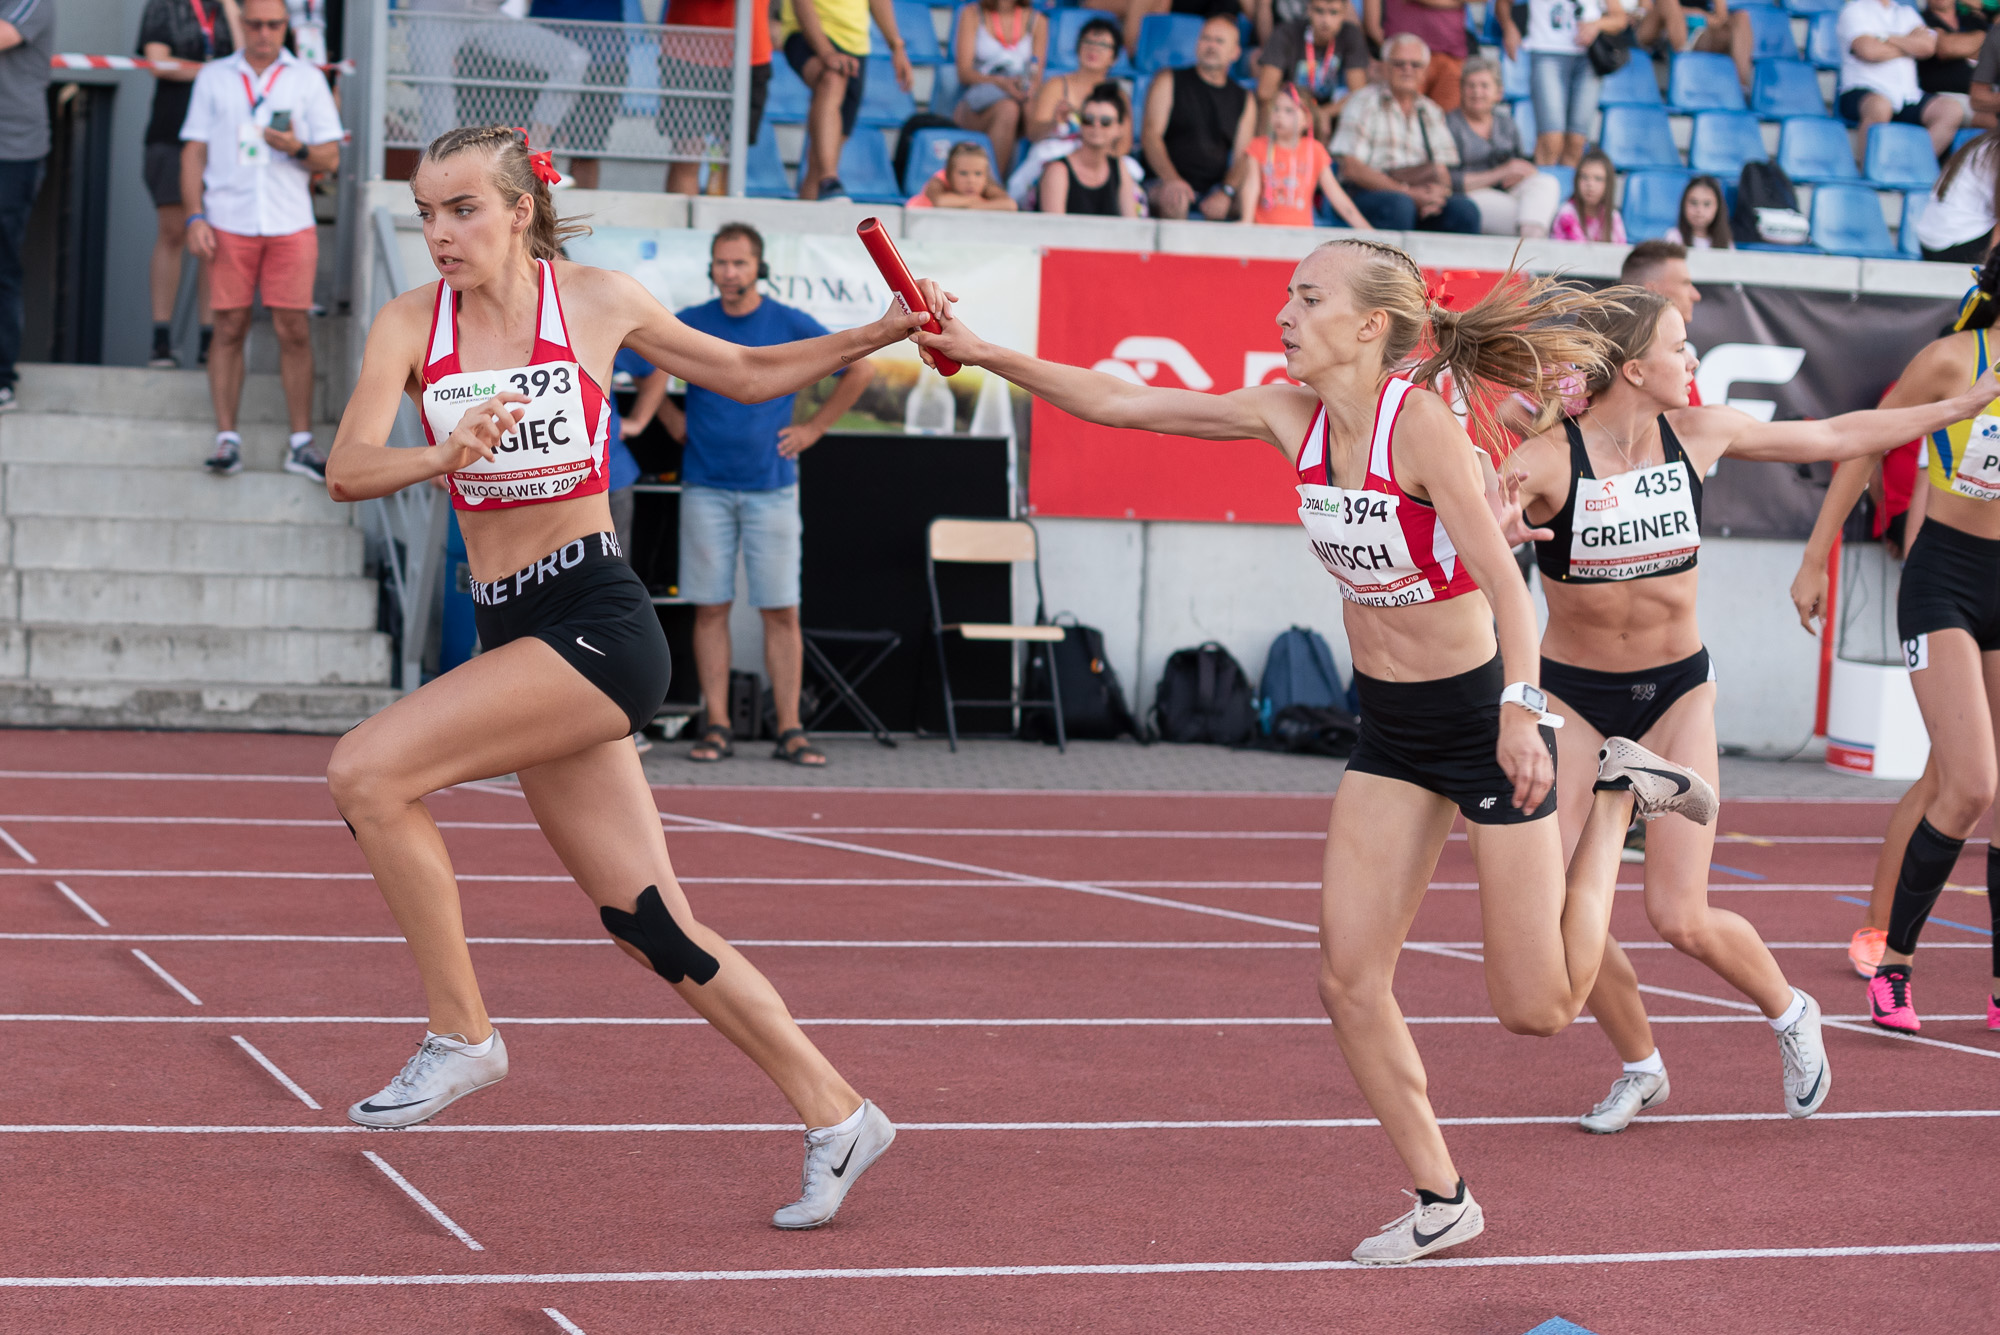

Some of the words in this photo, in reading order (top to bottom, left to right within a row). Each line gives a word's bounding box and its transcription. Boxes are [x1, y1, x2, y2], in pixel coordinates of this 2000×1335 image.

[434, 383, 496, 402] TOTALbet
[510, 367, 571, 398] 393
[449, 410, 571, 455] GIĘĆ
[484, 469, 541, 481] MISTRZOSTWA
[541, 465, 571, 476] POLSKI
[1634, 469, 1682, 498] 435
[460, 482, 548, 498] WŁOCŁAWEK
[1344, 496, 1388, 525] 394
[1581, 510, 1690, 548] GREINER
[515, 538, 586, 596] PRO
[1312, 539, 1394, 570] NITSCH
[1578, 562, 1661, 578] WŁOCŁAWEK
[1391, 587, 1424, 607] 2021
[1907, 638, 1920, 668] 8
[1478, 796, 1498, 810] 4F
